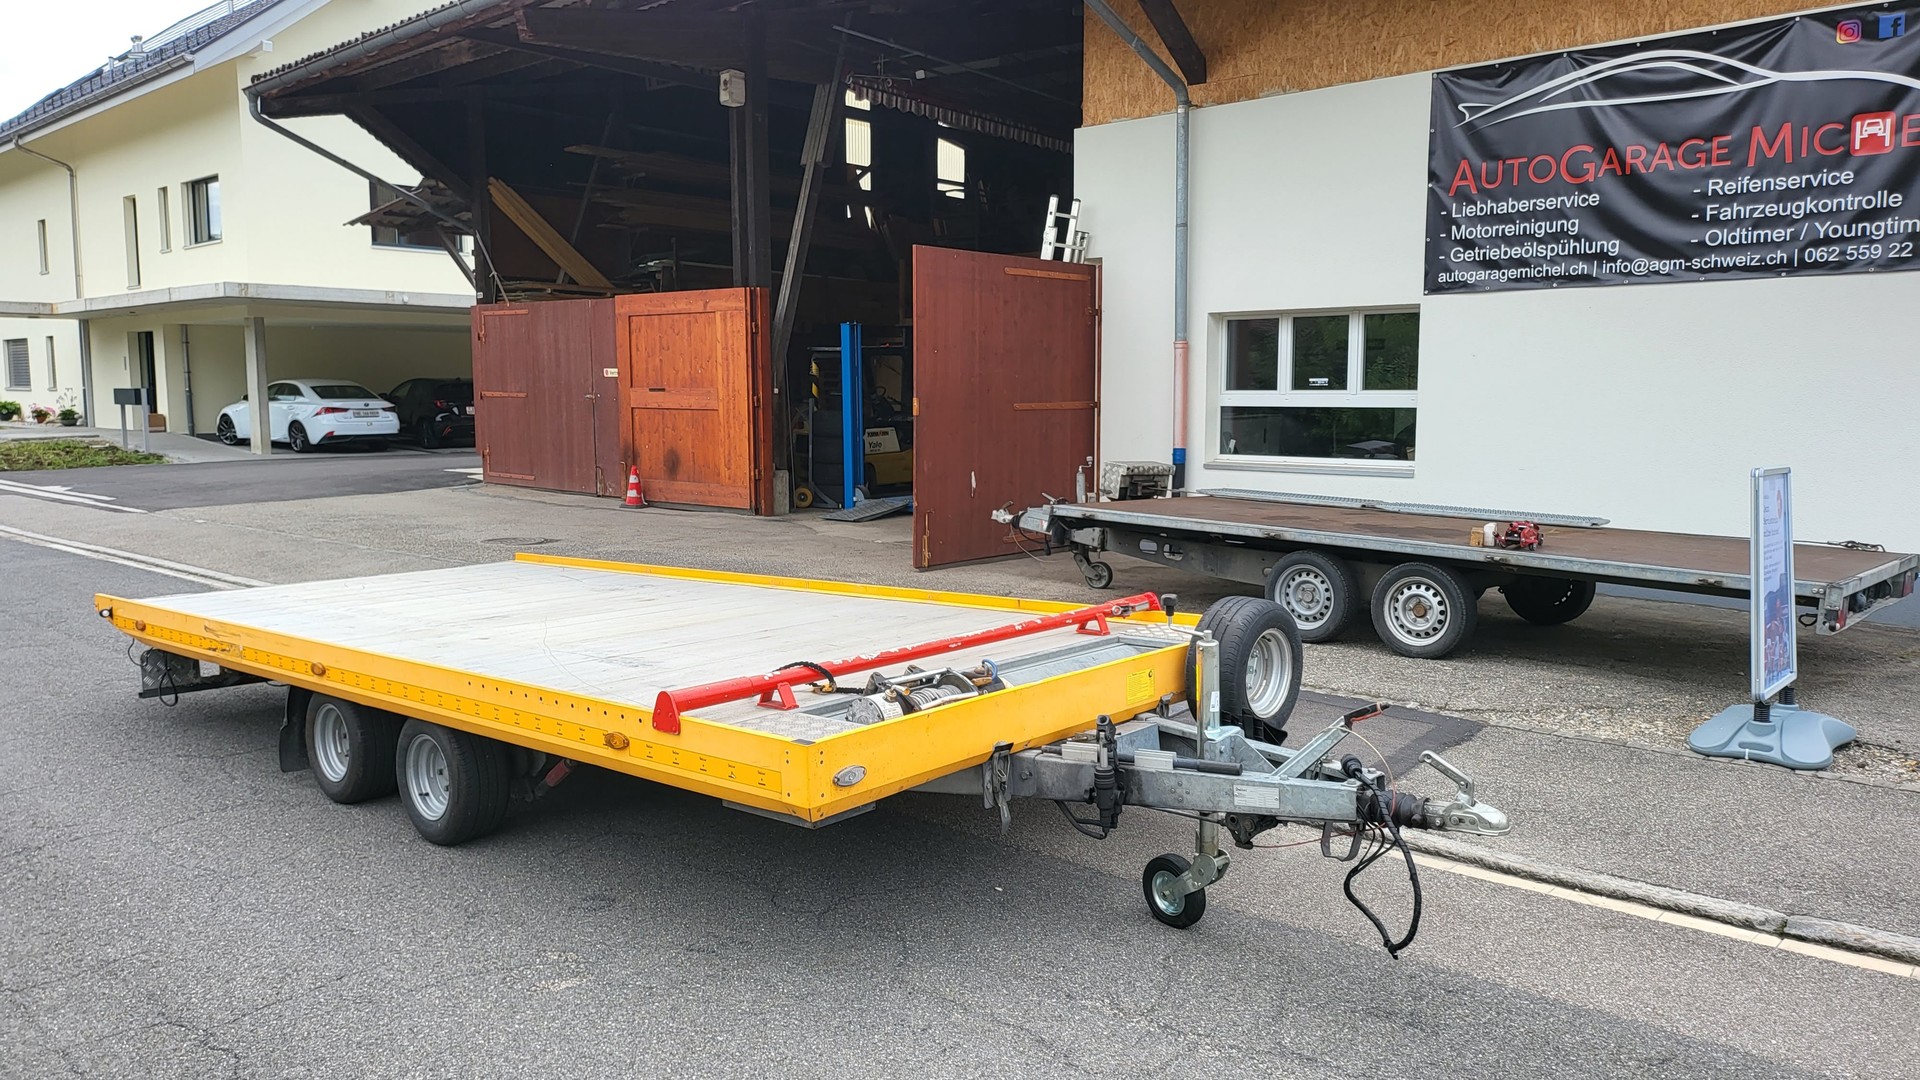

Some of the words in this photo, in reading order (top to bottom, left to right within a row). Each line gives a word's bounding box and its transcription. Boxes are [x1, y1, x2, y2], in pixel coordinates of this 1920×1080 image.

[1707, 169, 1855, 198] Reifenservice
[1451, 193, 1600, 218] Liebhaberservice
[1705, 190, 1903, 222] Fahrzeugkontrolle
[1450, 218, 1579, 241] Motorreinigung
[1704, 226, 1795, 247] Oldtimer
[1799, 222, 1809, 240] /
[1814, 216, 1920, 240] Youngtim
[1437, 261, 1588, 284] autogaragemichel.ch
[1601, 249, 1788, 276] info@agm-schweiz.ch
[1804, 246, 1840, 263] 062
[1845, 244, 1882, 260] 559
[1887, 241, 1913, 258] 22
[1449, 238, 1620, 264] Getriebeölspühlung
